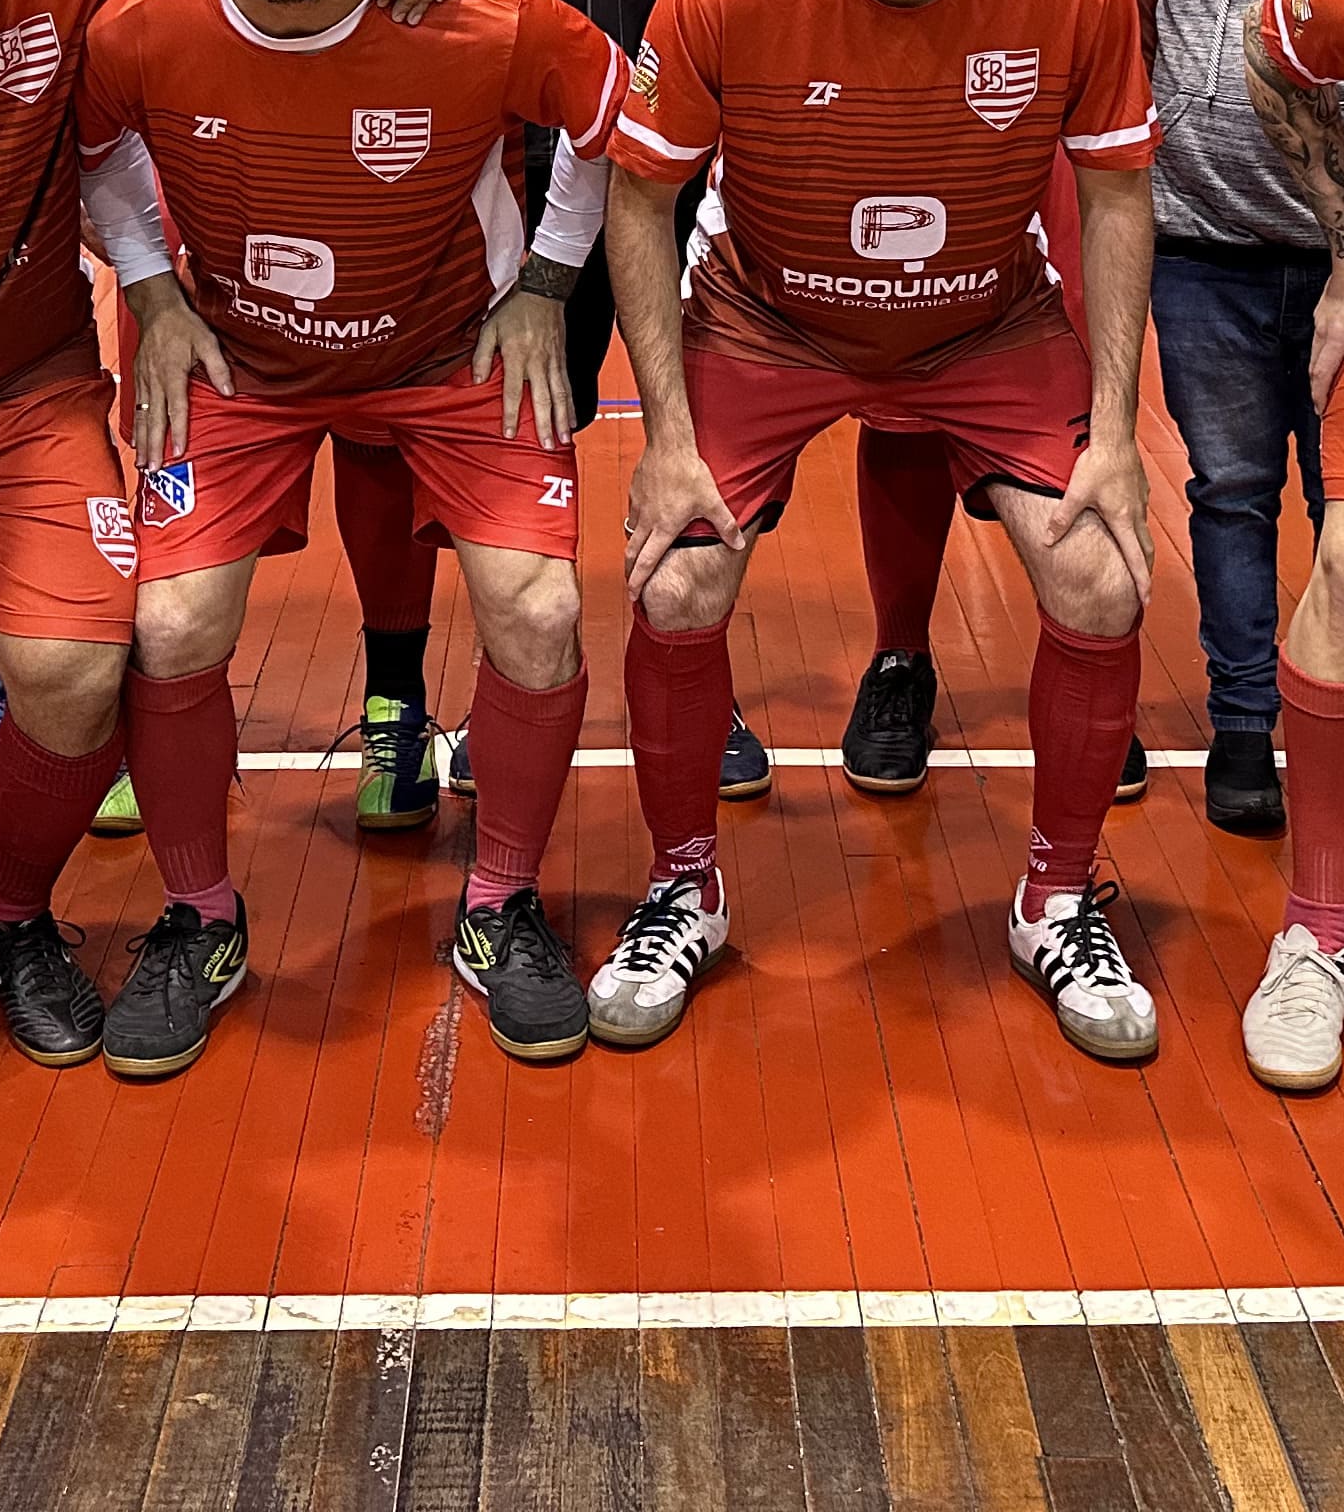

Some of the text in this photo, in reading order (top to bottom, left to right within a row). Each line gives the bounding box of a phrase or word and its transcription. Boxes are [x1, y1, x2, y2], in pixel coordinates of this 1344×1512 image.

[803, 81, 842, 106] ZF
[191, 115, 228, 139] ZF
[782, 267, 999, 299] PROQUIMIA
[537, 475, 573, 508] ZF
[202, 943, 226, 978] umbro
[476, 928, 497, 965] umbro
